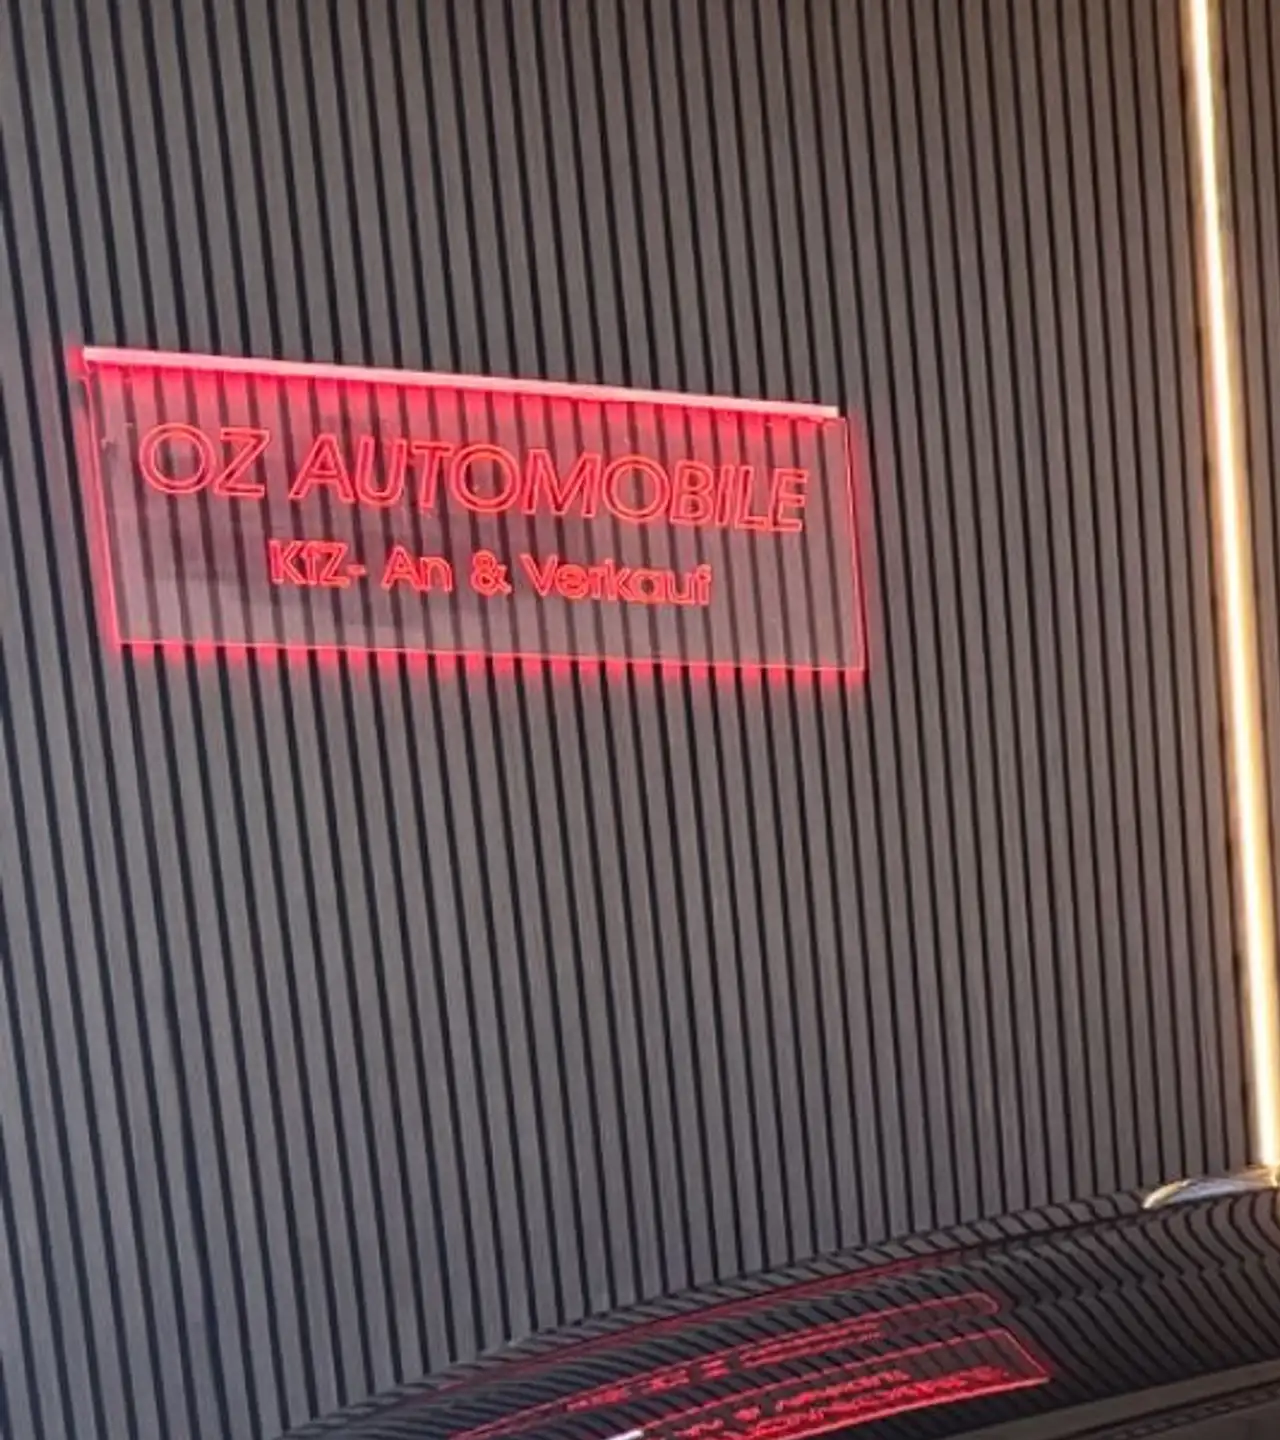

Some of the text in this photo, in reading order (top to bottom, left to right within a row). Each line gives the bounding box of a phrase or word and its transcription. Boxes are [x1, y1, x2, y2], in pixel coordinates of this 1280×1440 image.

[138, 422, 810, 533] OZ AUTOMOBILE
[380, 545, 453, 591] An
[470, 549, 513, 597] &
[519, 553, 713, 606] Verkauf
